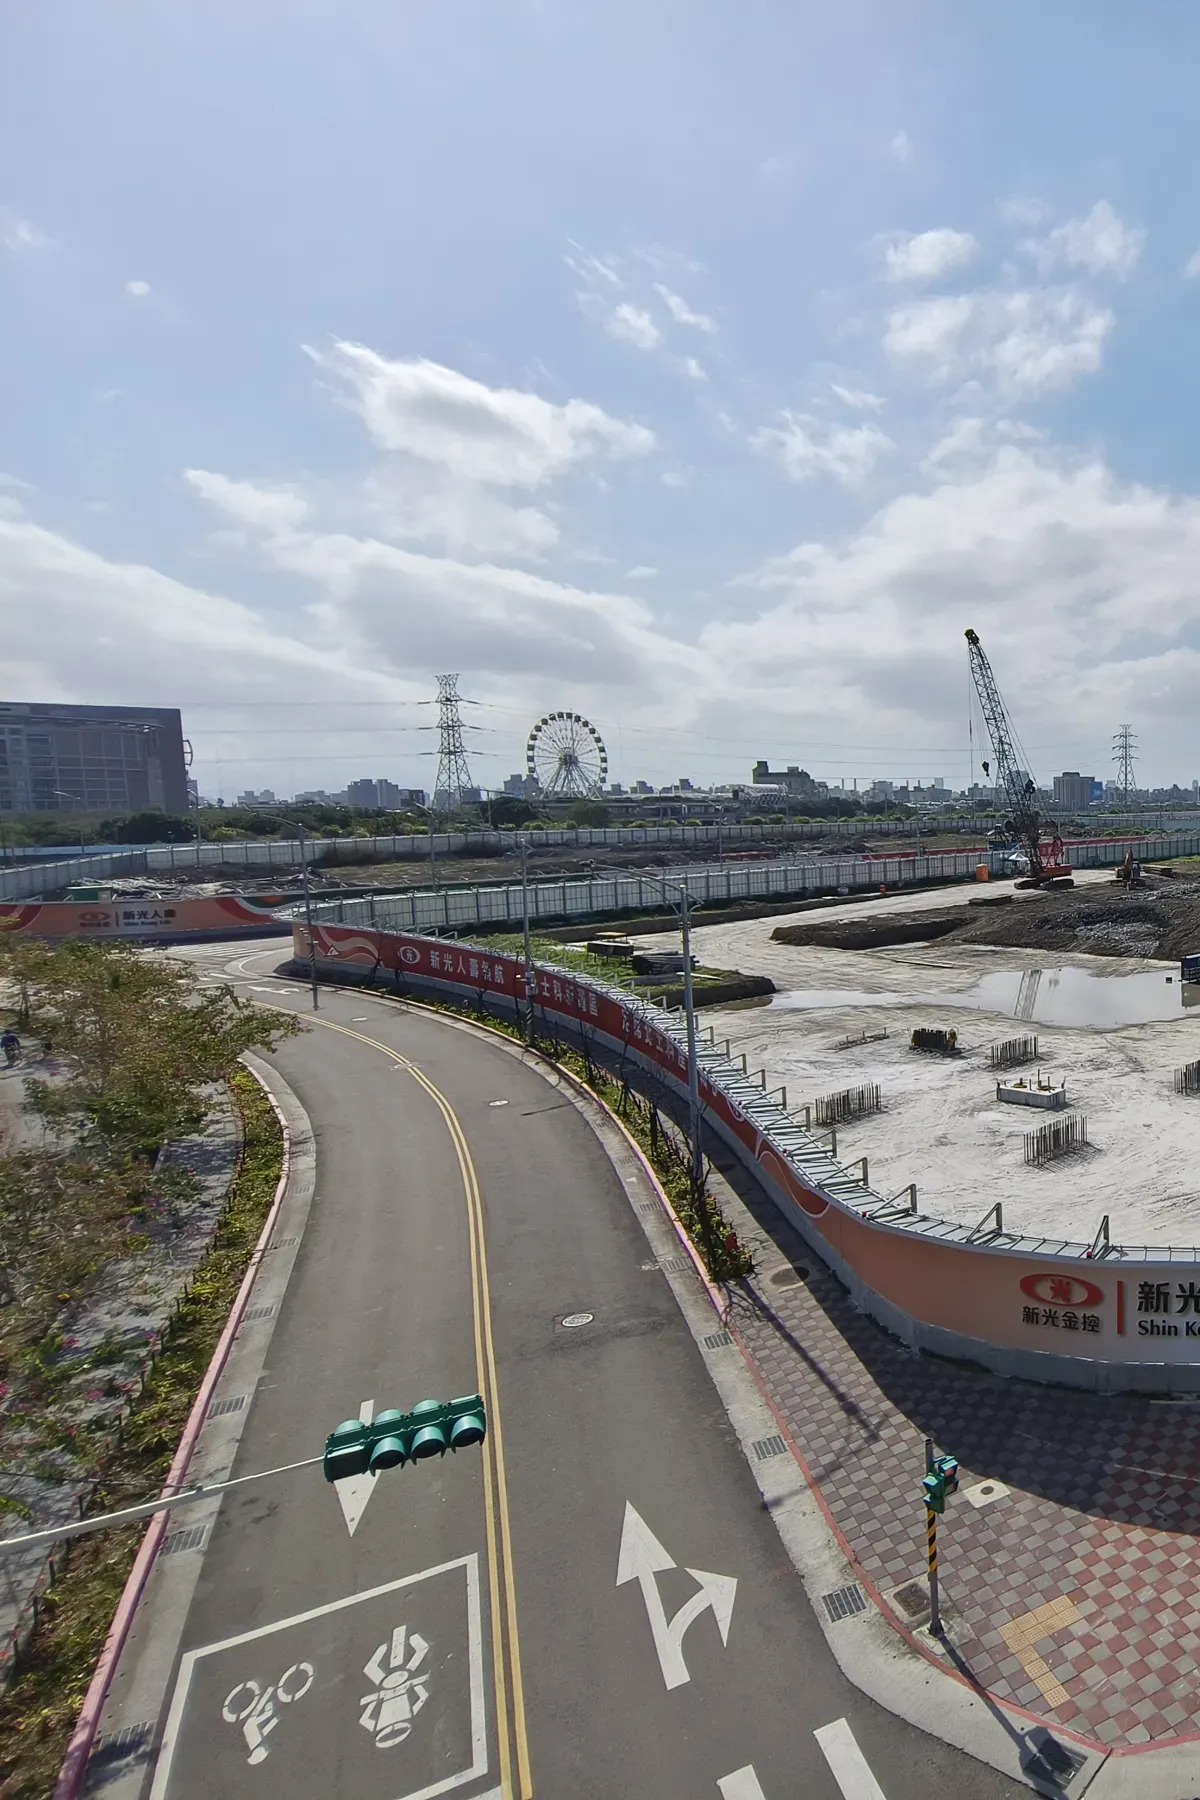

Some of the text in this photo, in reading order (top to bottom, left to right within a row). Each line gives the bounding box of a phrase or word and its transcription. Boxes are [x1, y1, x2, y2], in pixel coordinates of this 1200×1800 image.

[1022, 1306, 1101, 1333] 新光金控
[1138, 1319, 1179, 1338] Shin
